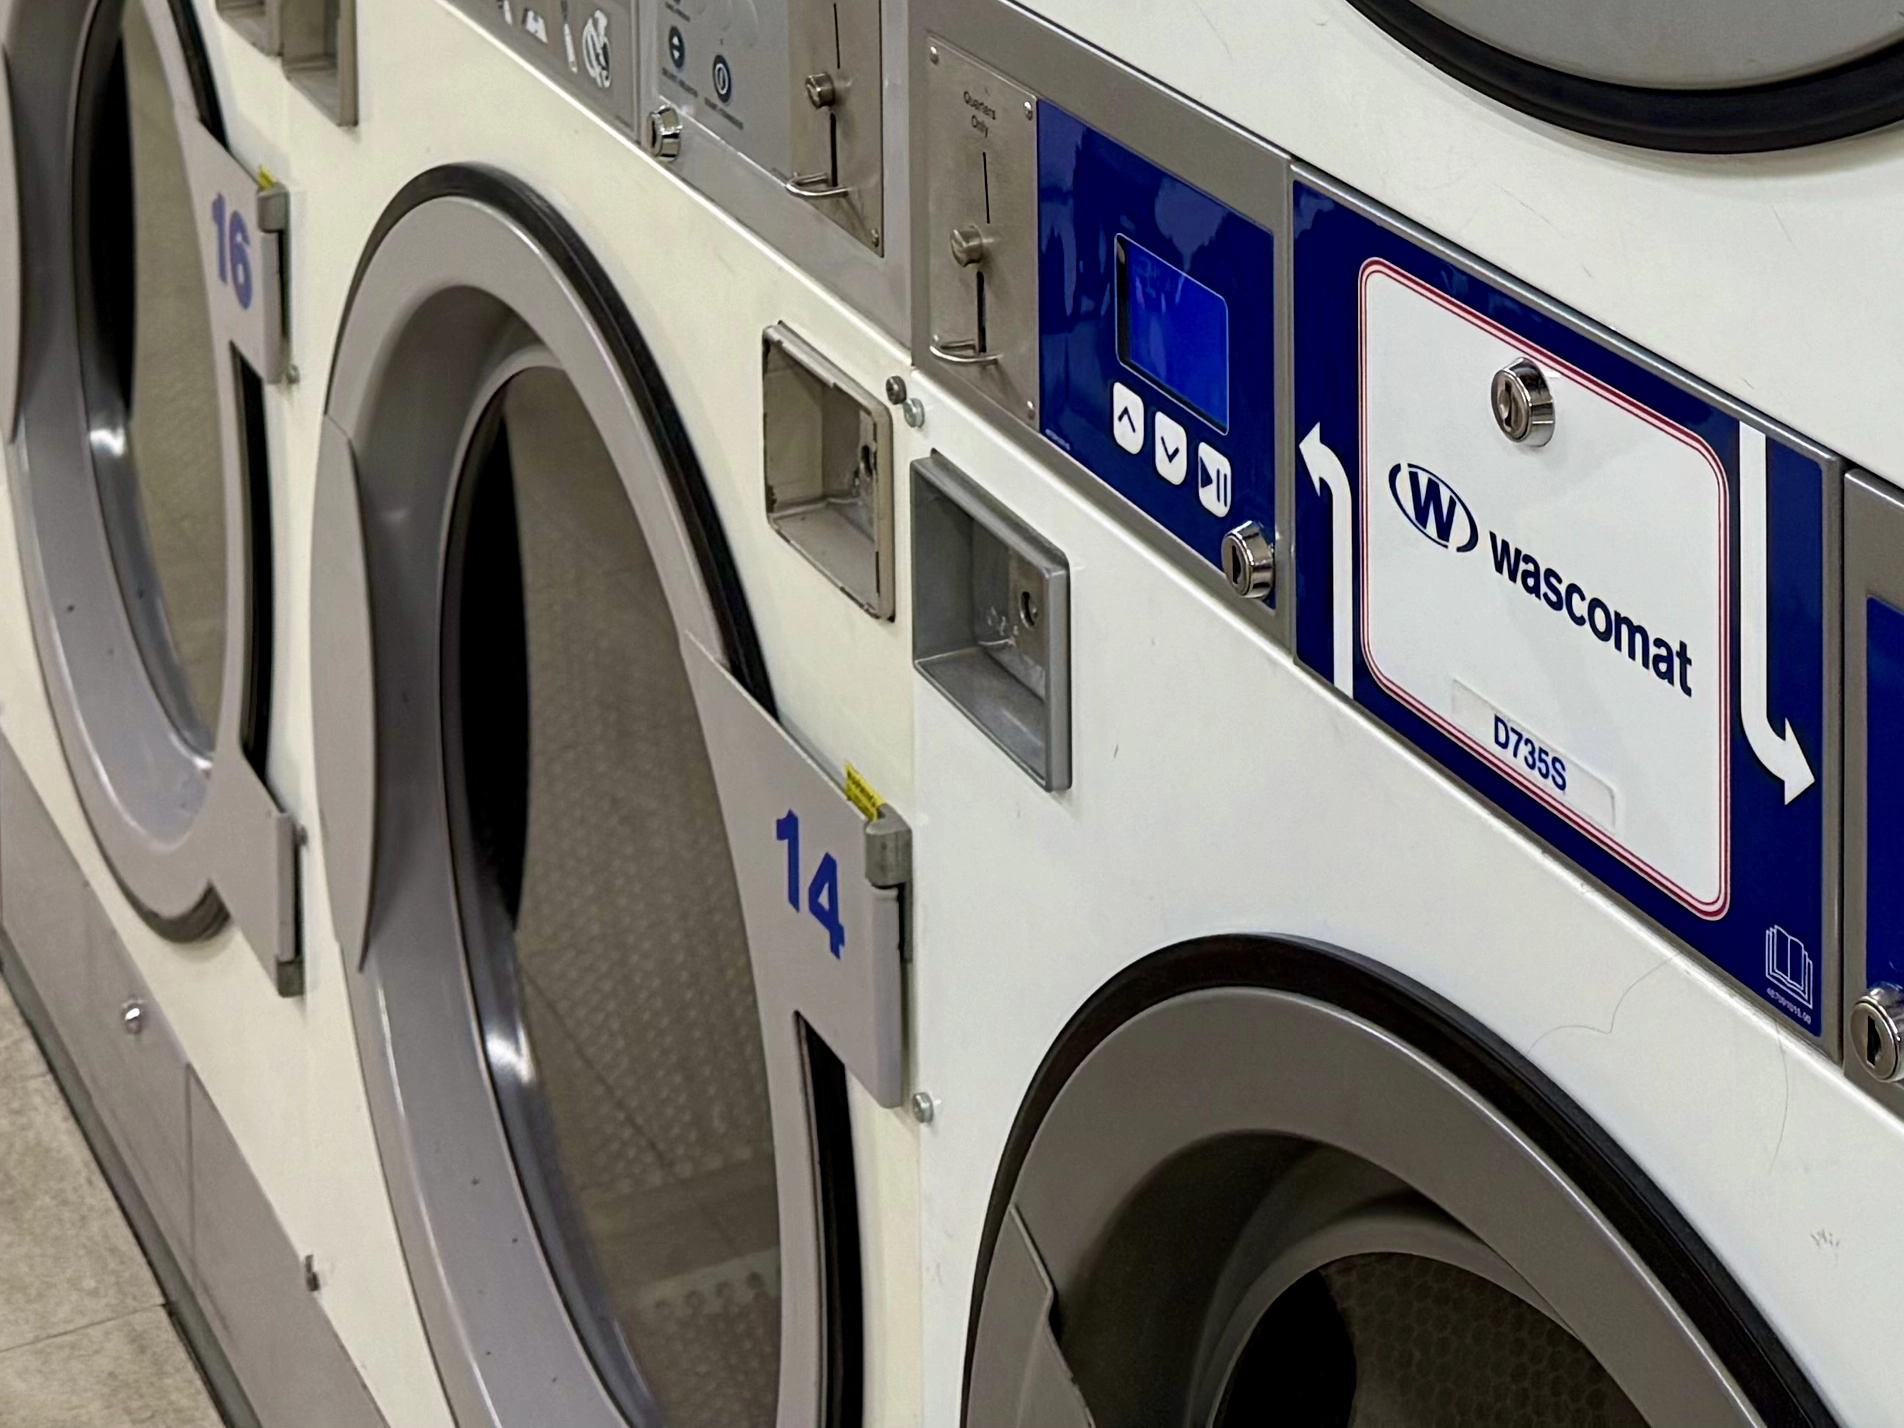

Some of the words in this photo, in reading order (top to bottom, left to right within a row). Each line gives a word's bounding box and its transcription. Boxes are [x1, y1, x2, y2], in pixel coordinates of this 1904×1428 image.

[963, 90, 996, 121] Quarters
[211, 191, 253, 311] 16
[1489, 530, 1694, 698] wascomat
[1493, 712, 1568, 793] D735S
[775, 807, 846, 961] 14
